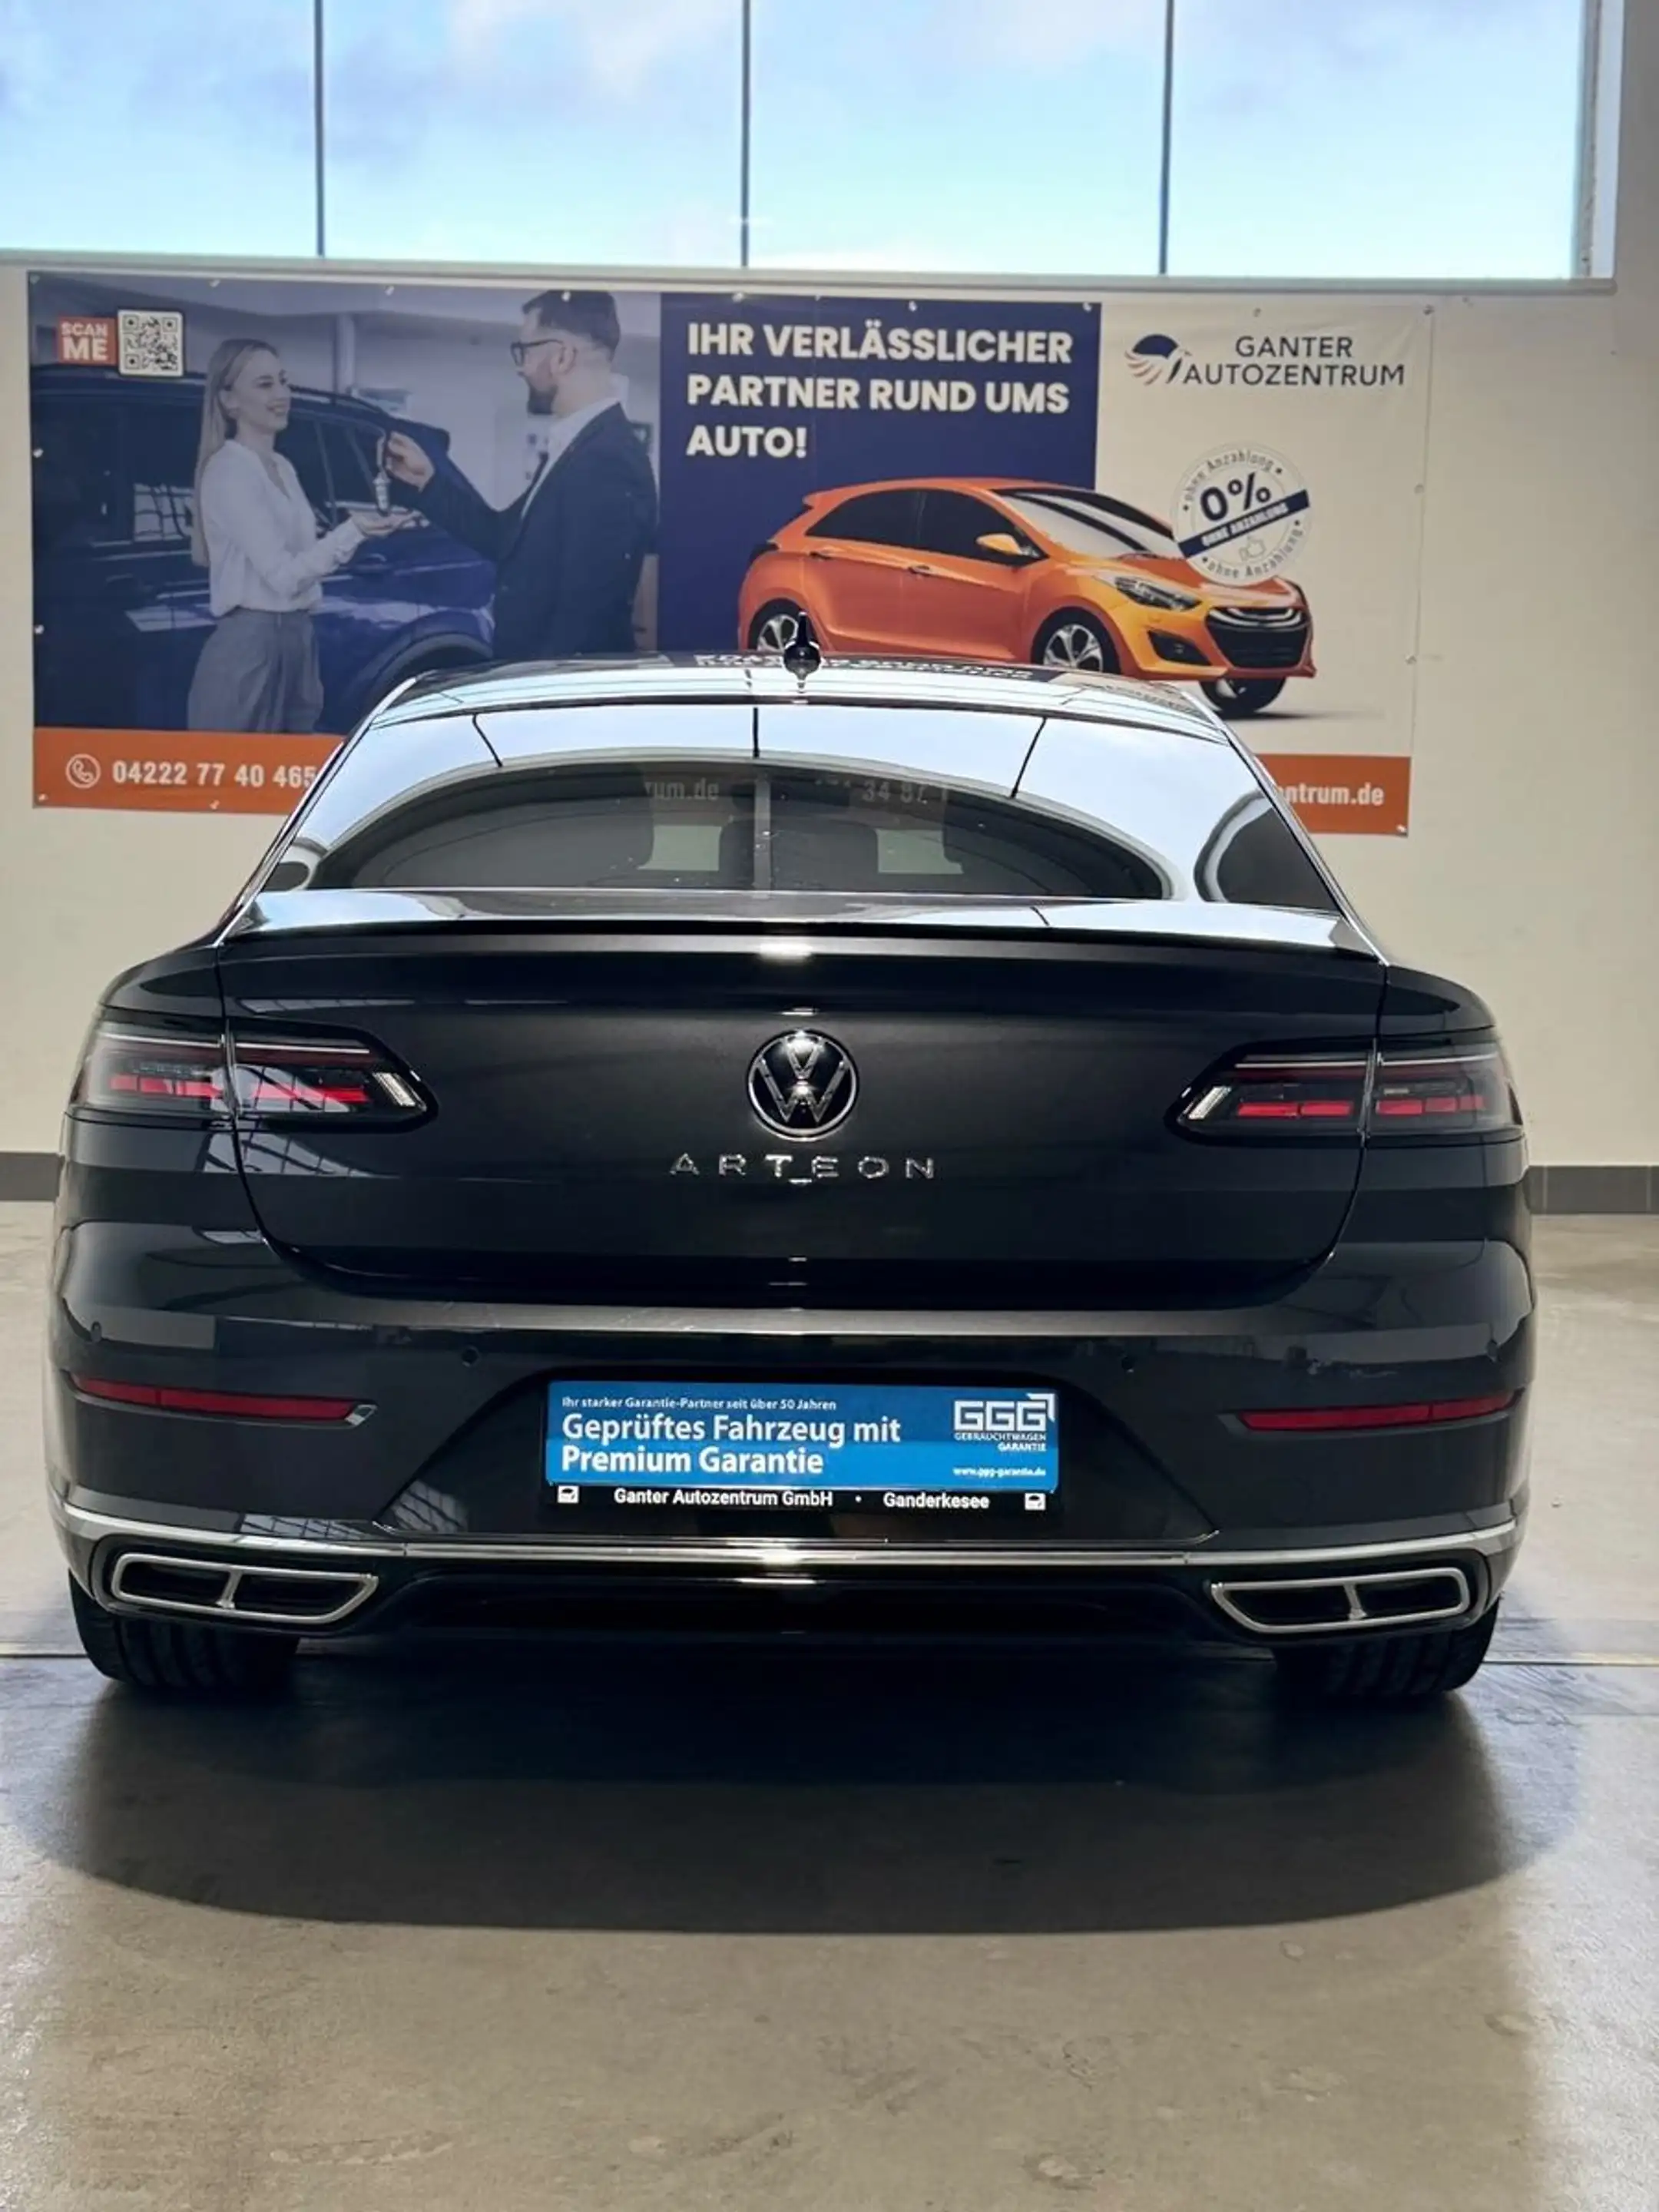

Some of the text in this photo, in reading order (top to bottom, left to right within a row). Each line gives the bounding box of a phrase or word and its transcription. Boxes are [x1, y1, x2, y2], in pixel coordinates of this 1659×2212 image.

[61, 322, 108, 336] SCAN
[688, 319, 1073, 363] IHR VERLÄSSLICHER
[63, 337, 108, 361] ME
[1235, 336, 1353, 358] GANTER
[1183, 363, 1405, 386] AUTOZENTRUM
[687, 373, 1070, 413] PARTNER RUND UMS
[686, 425, 807, 459] AUTO!
[1200, 472, 1272, 522] 0%
[112, 760, 187, 785] 04222
[197, 763, 226, 786] 77
[233, 764, 265, 788] 40
[670, 1152, 935, 1179] ARTEON
[561, 1396, 837, 1411] Ihr starker Garantie-Partner seit über 50 Jahren
[954, 1400, 1046, 1432] GGG
[562, 1412, 901, 1449] Geprüftes Fahrzeug mit
[561, 1444, 824, 1474] Premium Garantie
[997, 1442, 1047, 1452] GARANTIE
[614, 1487, 834, 1507] Ganter Autozentrum GmbH
[882, 1492, 991, 1509] Ganderkesee
